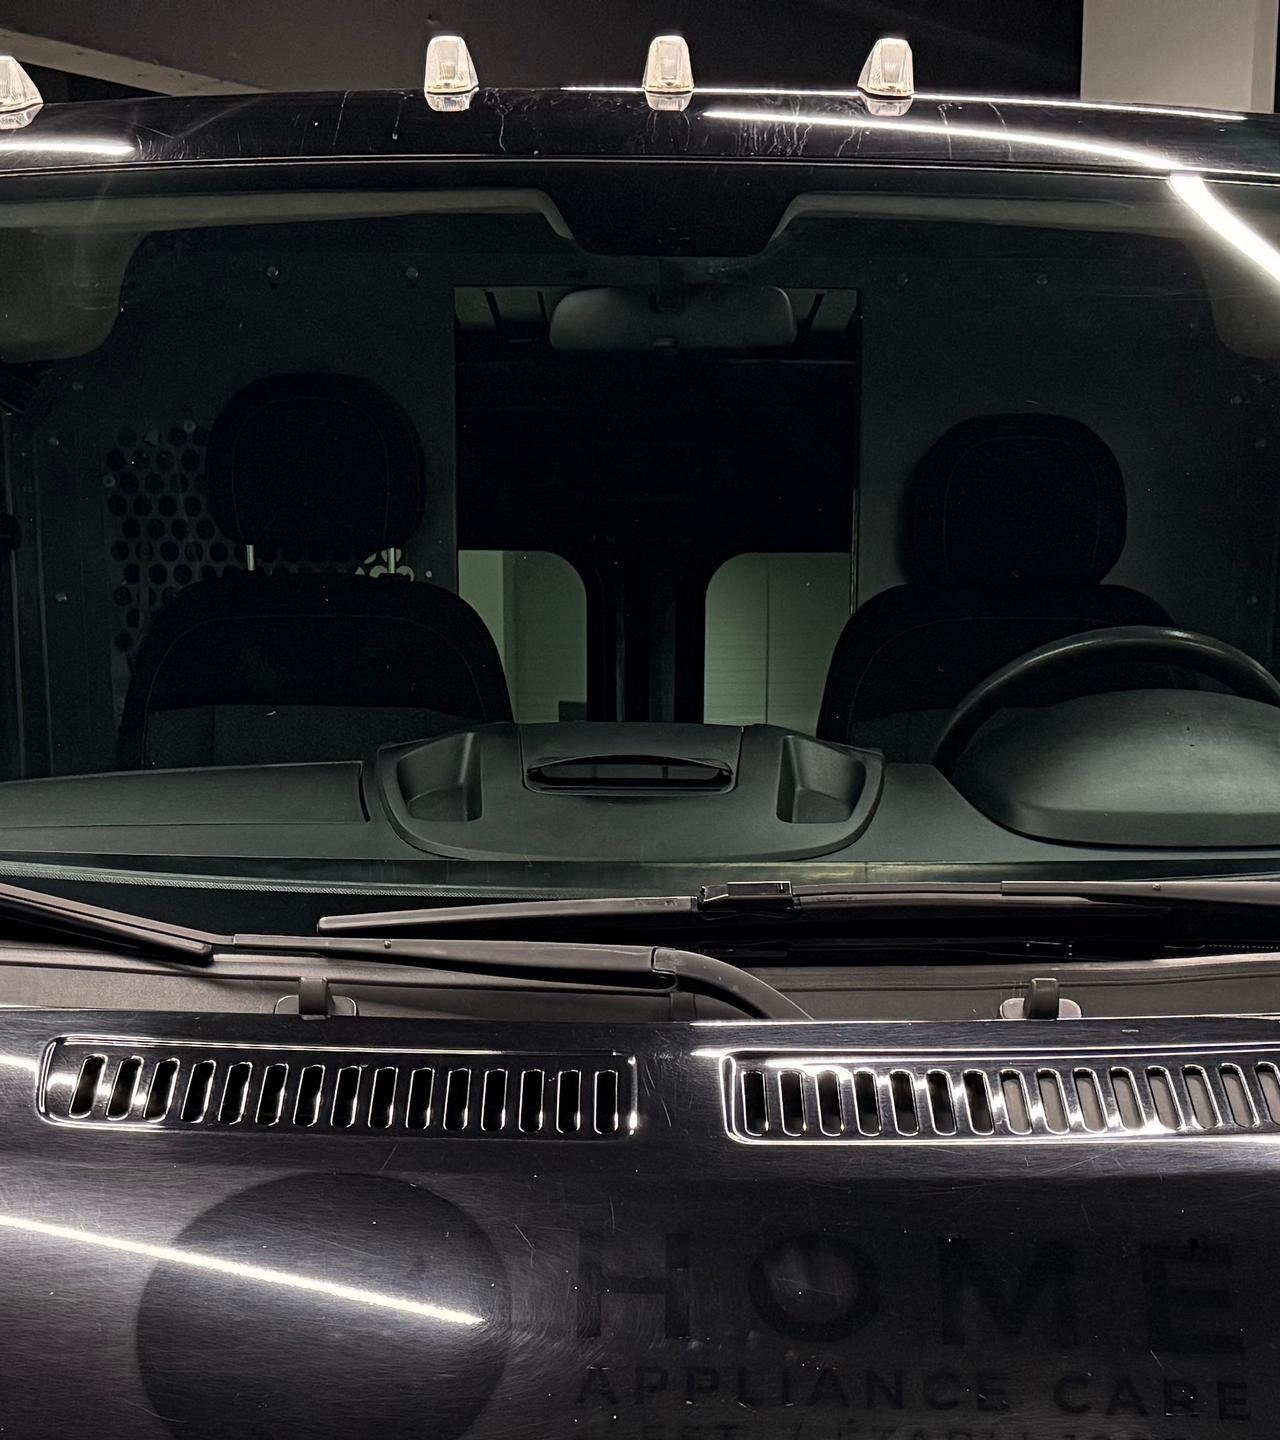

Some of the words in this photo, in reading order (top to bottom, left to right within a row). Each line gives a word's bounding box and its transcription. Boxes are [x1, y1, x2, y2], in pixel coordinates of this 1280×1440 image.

[576, 1231, 1243, 1355] HOME
[575, 1365, 1012, 1413] APPLIANCE
[1051, 1371, 1252, 1422] CARE
